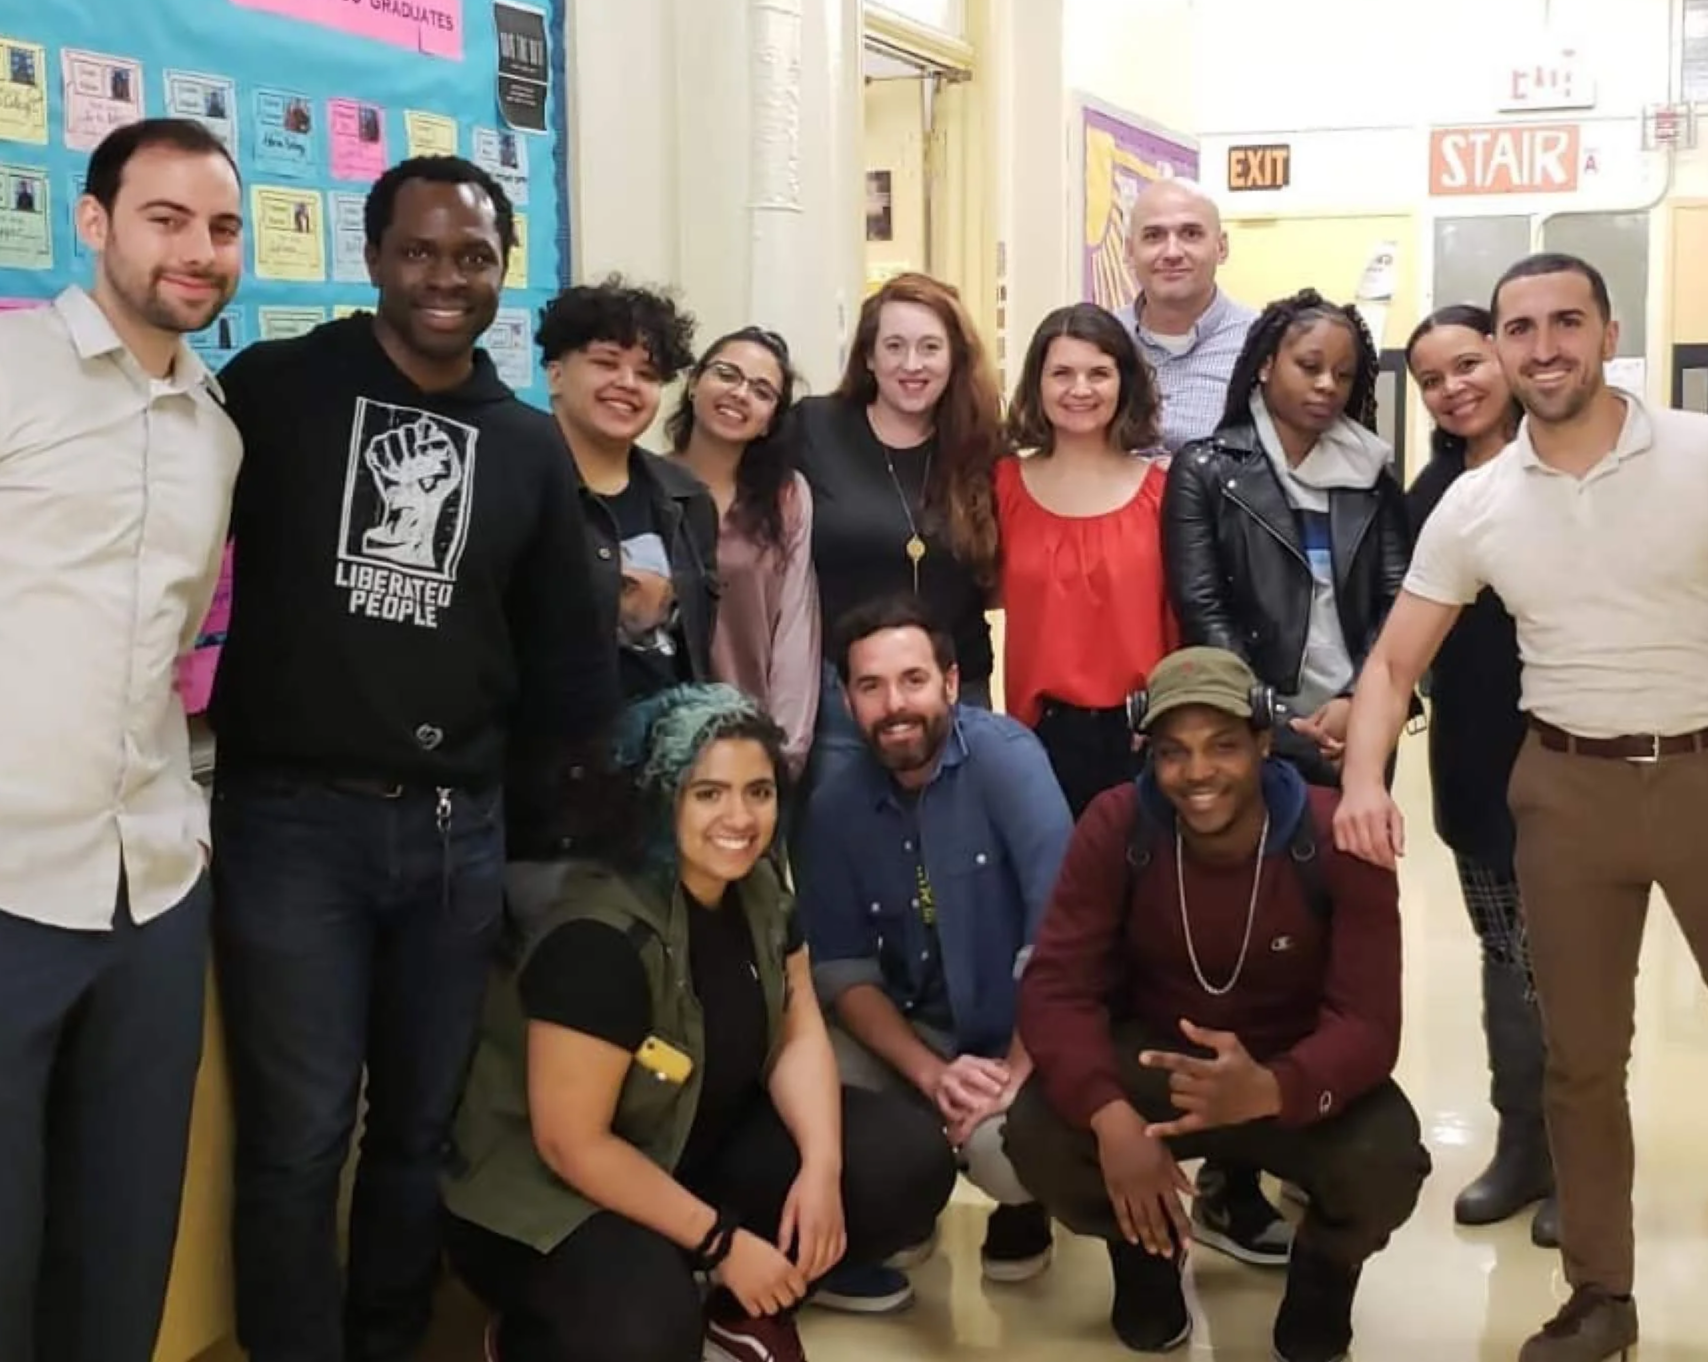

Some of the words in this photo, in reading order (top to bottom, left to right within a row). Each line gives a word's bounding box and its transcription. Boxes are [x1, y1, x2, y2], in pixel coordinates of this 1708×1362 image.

[369, 0, 454, 32] GRADUATES
[1230, 149, 1288, 187] EXIT
[1440, 129, 1569, 188] STAIR
[1584, 154, 1599, 175] A
[335, 562, 454, 608] LIBERATED
[349, 590, 438, 629] PEOPLE
